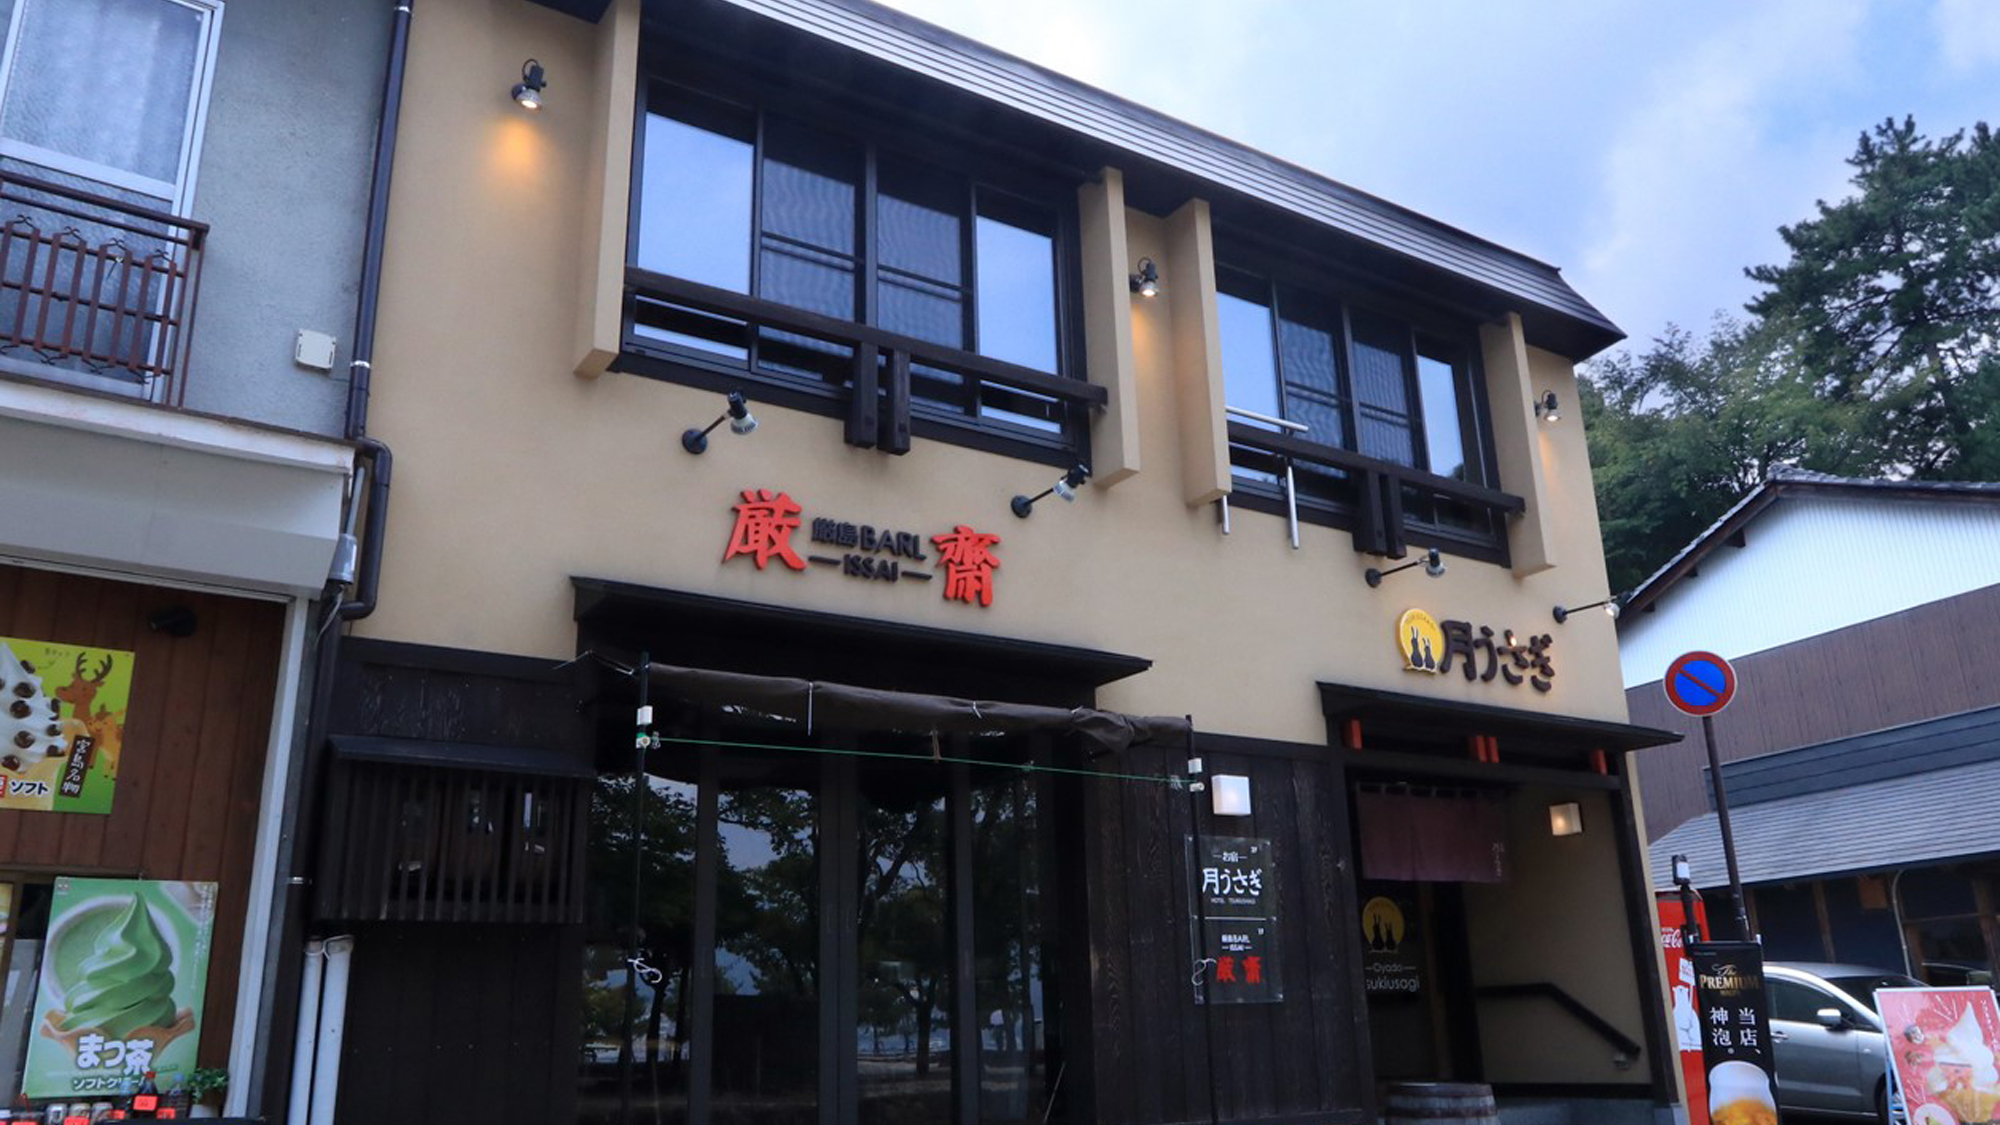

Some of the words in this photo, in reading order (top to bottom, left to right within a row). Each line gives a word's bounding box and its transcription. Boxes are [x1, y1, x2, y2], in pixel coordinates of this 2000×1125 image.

[722, 489, 806, 570] 厳
[843, 554, 898, 583] ISSAI
[1439, 619, 1555, 692] 月うさぎ
[61, 738, 91, 794] 宮島名物
[11, 781, 48, 795] ソフト
[1202, 867, 1262, 896] 月うさぎ
[1366, 975, 1420, 992] sukiusagi
[1699, 974, 1760, 990] PREMIUM
[1711, 963, 1738, 976] The
[76, 1033, 154, 1075] まつ茶
